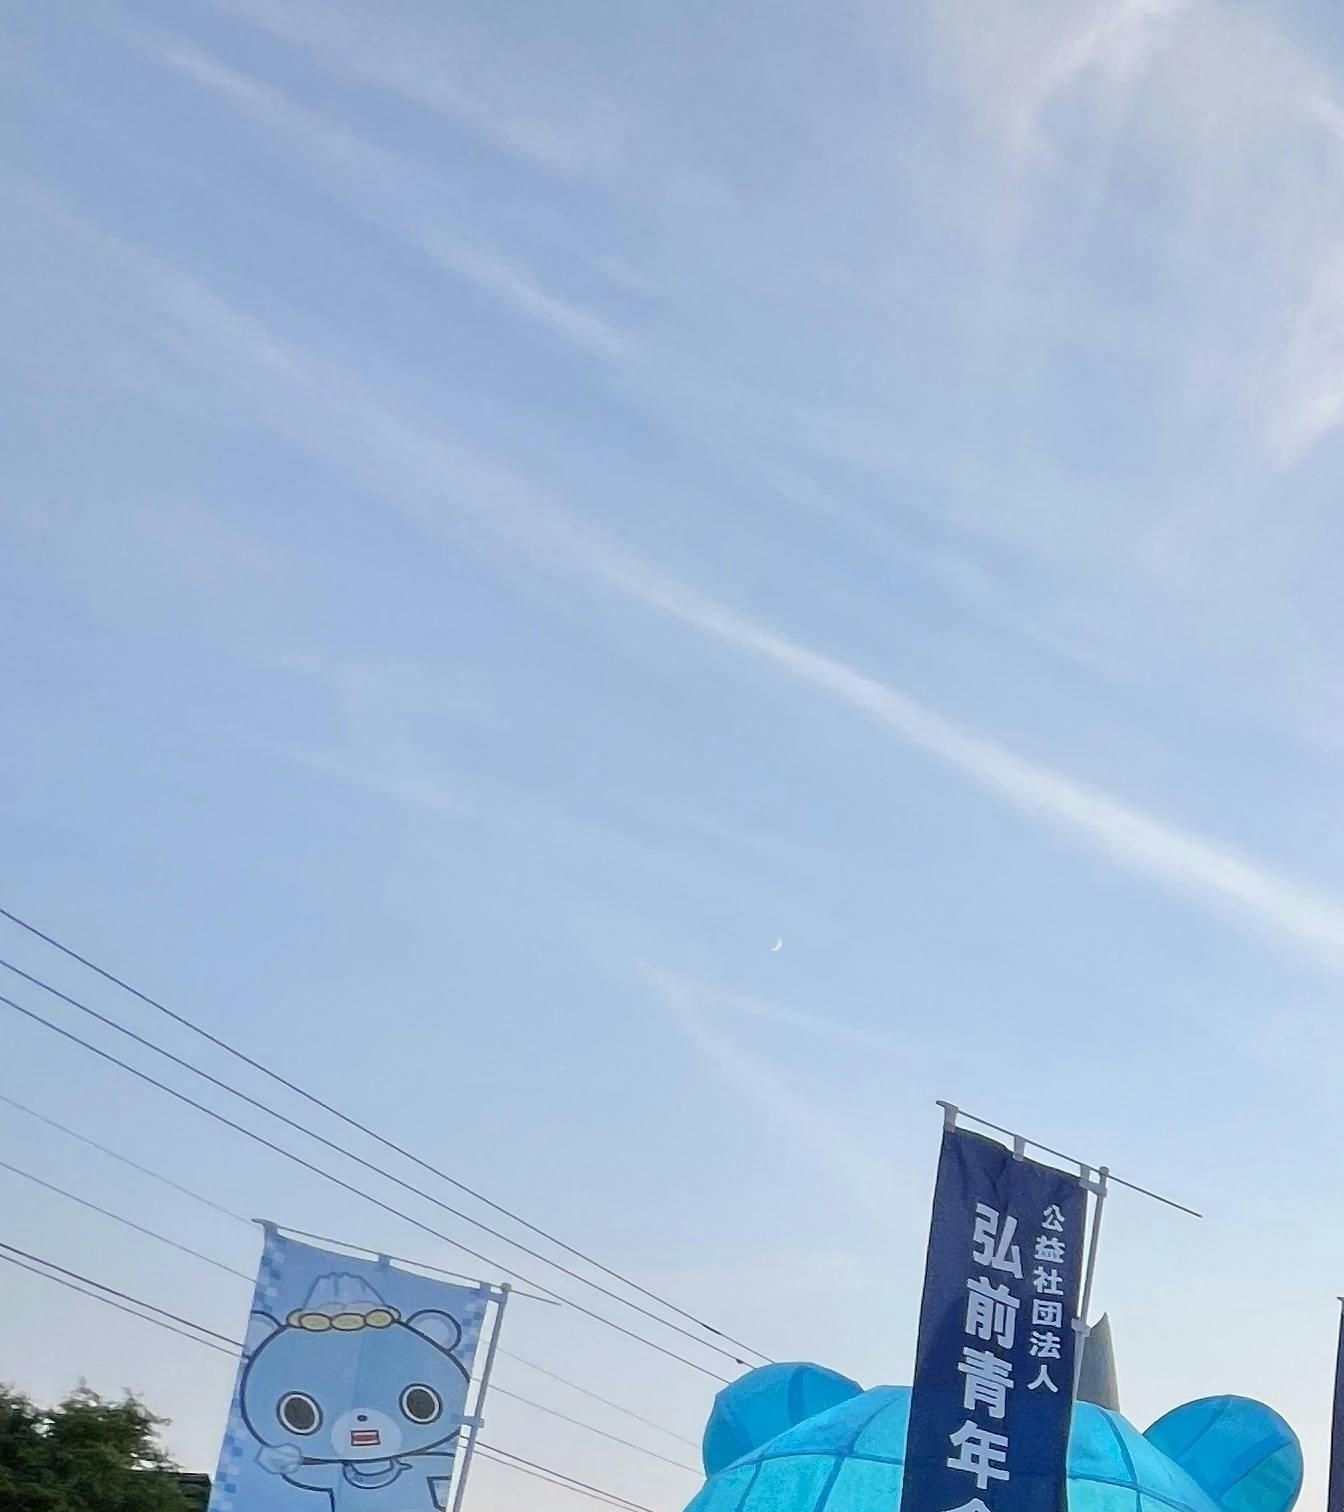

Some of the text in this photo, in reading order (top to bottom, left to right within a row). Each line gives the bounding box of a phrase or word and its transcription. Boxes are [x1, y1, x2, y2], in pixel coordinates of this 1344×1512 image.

[1026, 1203, 1067, 1394] 公益社団法人
